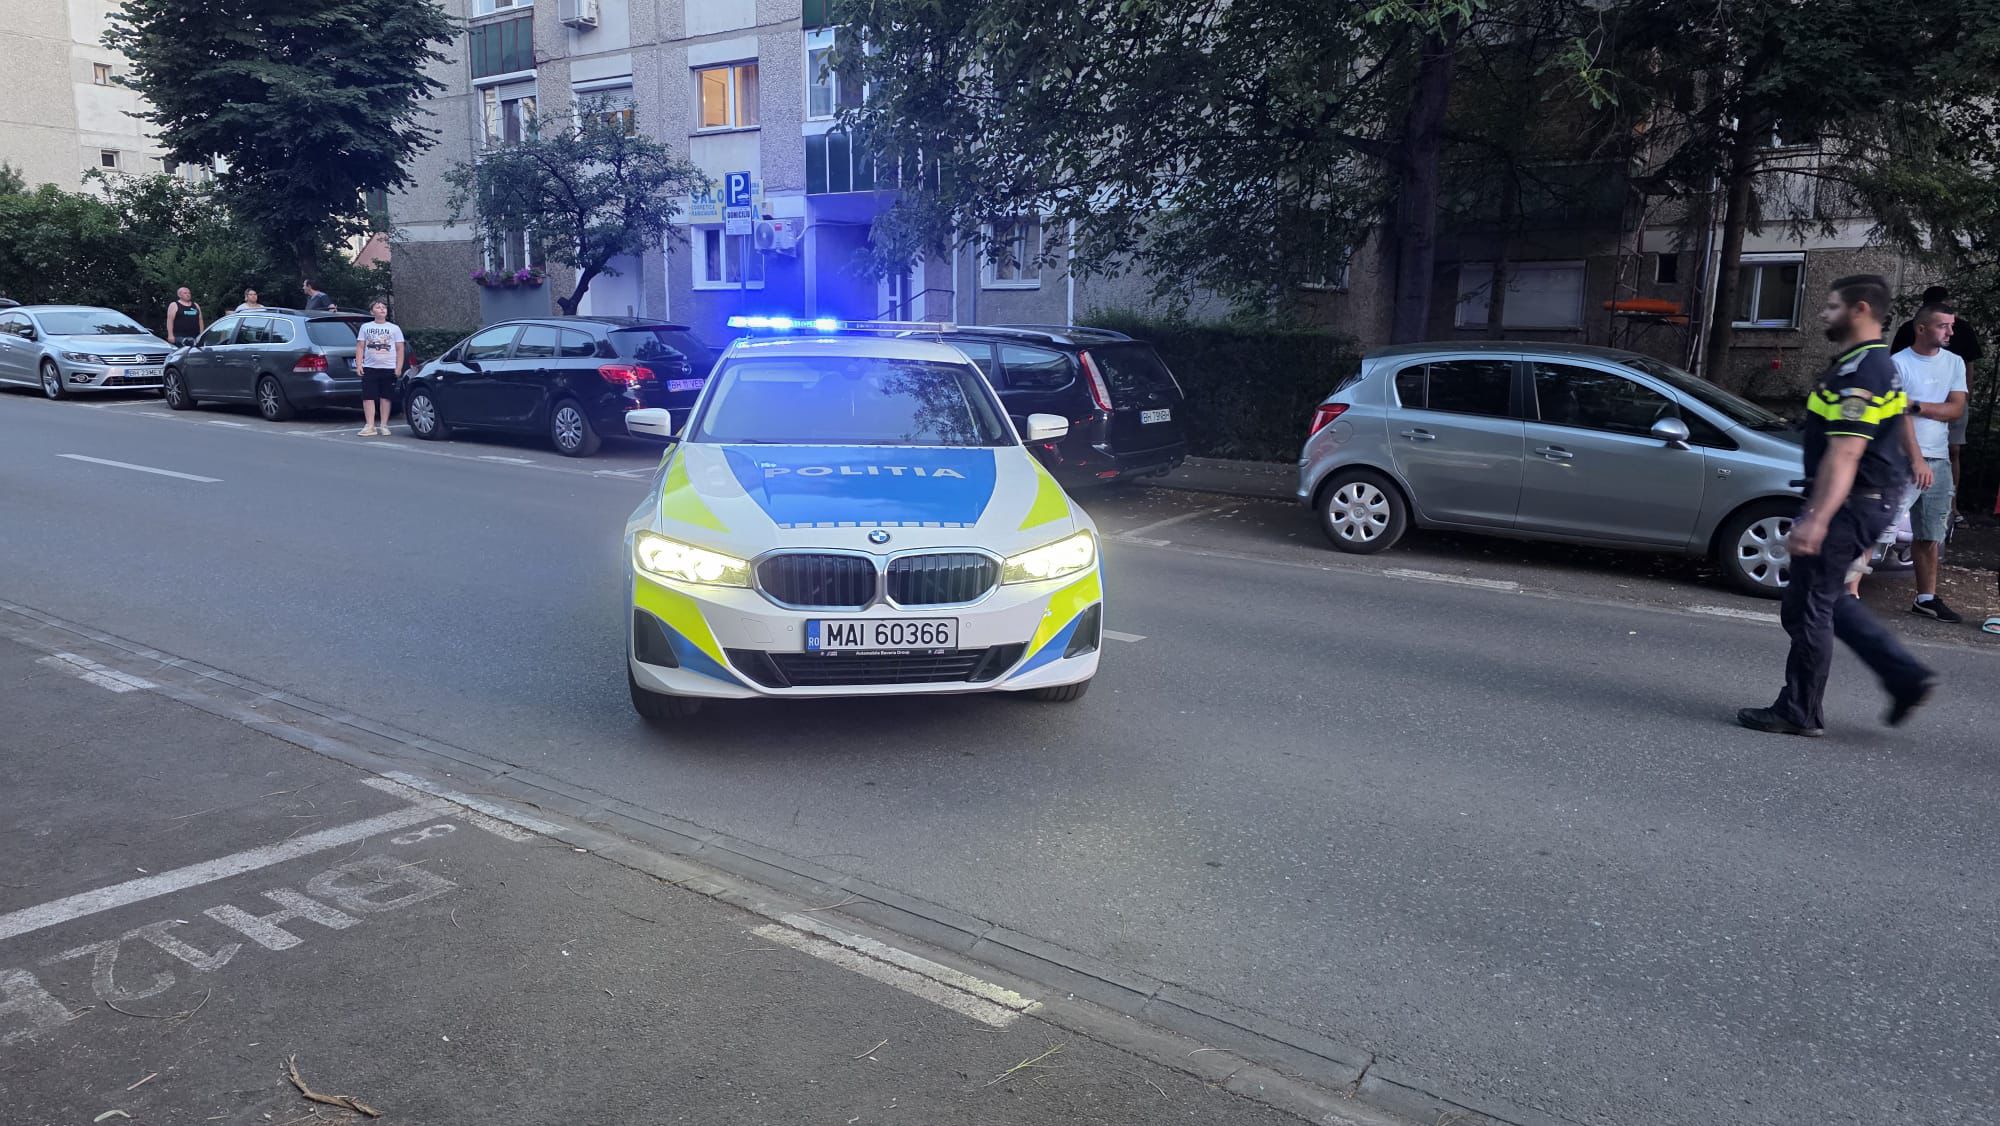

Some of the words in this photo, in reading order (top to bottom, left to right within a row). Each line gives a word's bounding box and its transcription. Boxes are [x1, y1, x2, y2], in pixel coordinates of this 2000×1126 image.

[731, 174, 745, 204] P
[764, 465, 967, 479] POLITIA
[808, 636, 820, 647] RO
[827, 623, 865, 647] MAI
[875, 622, 949, 646] 60366
